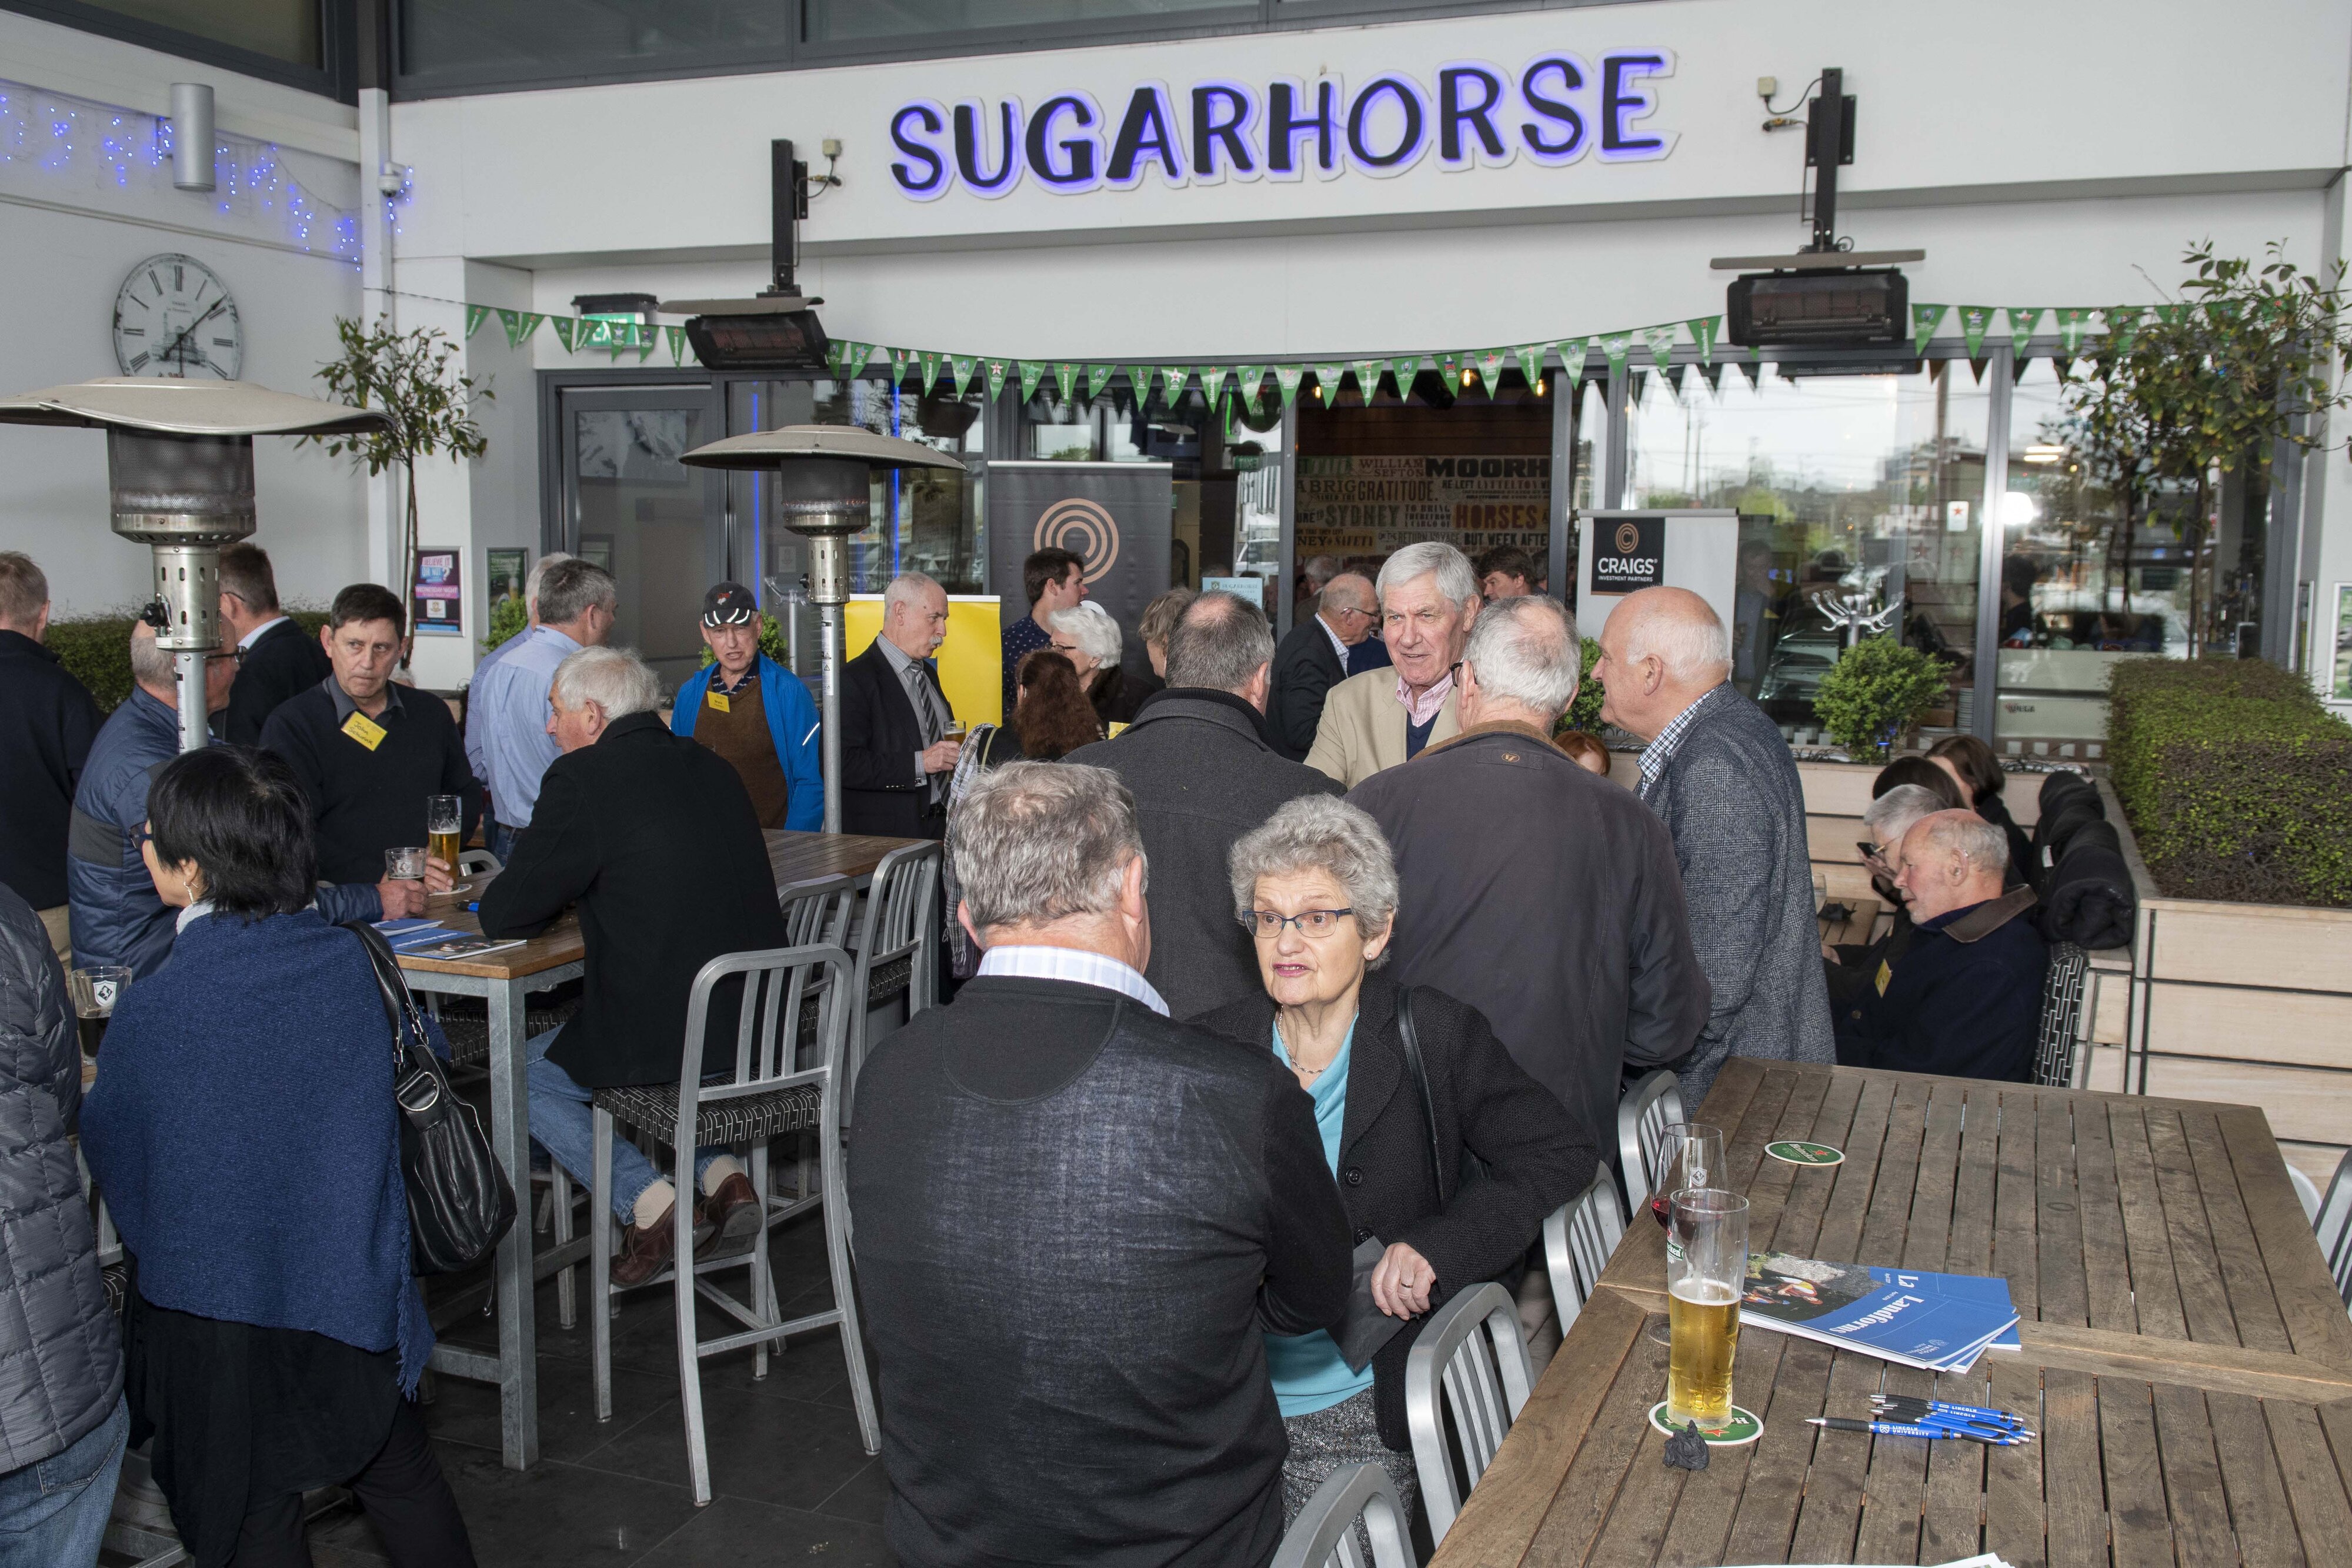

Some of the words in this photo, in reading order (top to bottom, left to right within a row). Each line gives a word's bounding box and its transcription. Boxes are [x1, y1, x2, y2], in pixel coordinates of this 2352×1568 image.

[889, 54, 1666, 189] SUGARHORSE
[1702, 328, 1710, 357] Heineken
[1359, 458, 1423, 469] WILLIAM
[1425, 458, 1549, 478] MOORH
[1374, 469, 1423, 477] SEFTON
[1310, 479, 1356, 492] BRIG
[1325, 504, 1400, 527] SYDNEY
[1456, 505, 1537, 529] HORSES
[1464, 533, 1484, 545] BUT
[1487, 533, 1517, 546] WEEK
[1598, 558, 1654, 575] CRAIGS
[353, 720, 369, 736] John
[1789, 1143, 1819, 1162] Heineken
[1898, 1275, 1919, 1288] La
[1829, 1295, 1925, 1333] Landforms
